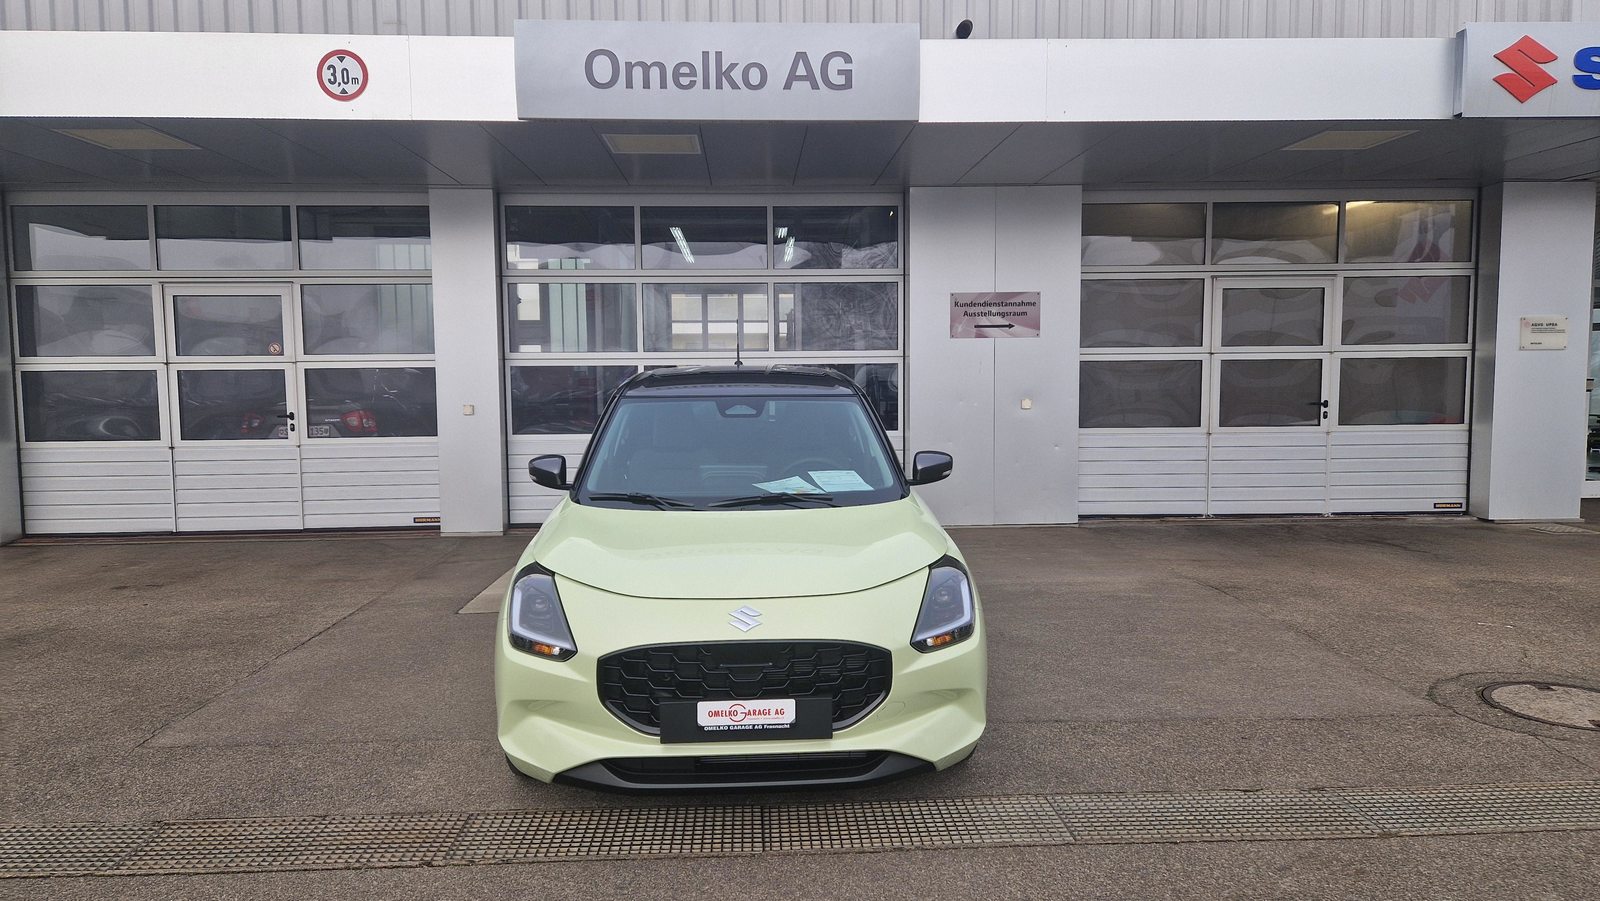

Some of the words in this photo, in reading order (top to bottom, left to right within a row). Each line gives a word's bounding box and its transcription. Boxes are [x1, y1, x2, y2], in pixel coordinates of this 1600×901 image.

[584, 48, 768, 91] Omelko
[782, 50, 853, 91] AG
[954, 300, 1037, 308] Kundendienstannahme
[963, 310, 1028, 319] Ausstellungsraum
[707, 709, 738, 718] OMELKO
[774, 708, 785, 716] AG
